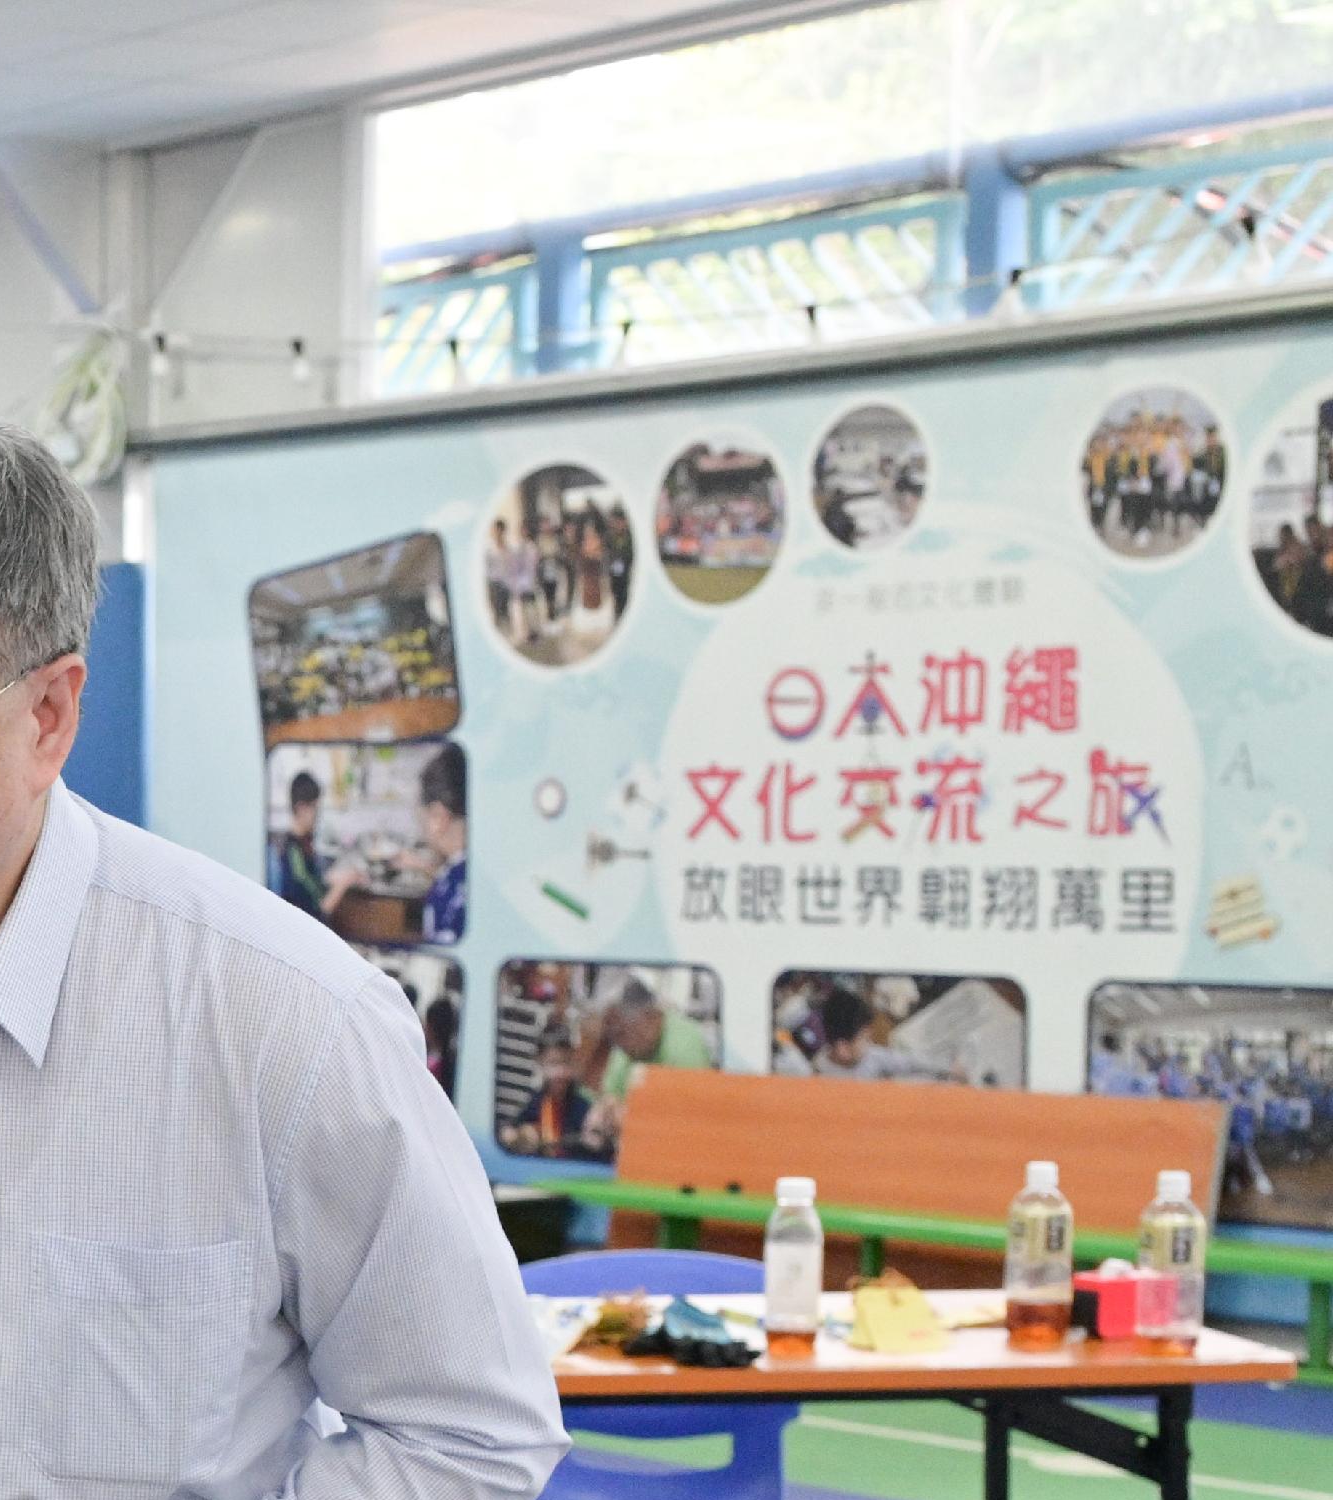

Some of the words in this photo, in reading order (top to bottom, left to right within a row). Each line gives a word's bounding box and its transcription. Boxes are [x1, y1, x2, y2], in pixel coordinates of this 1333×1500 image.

[764, 645, 1081, 740] 日本沖繩
[683, 746, 1170, 845] 文化交流之旅
